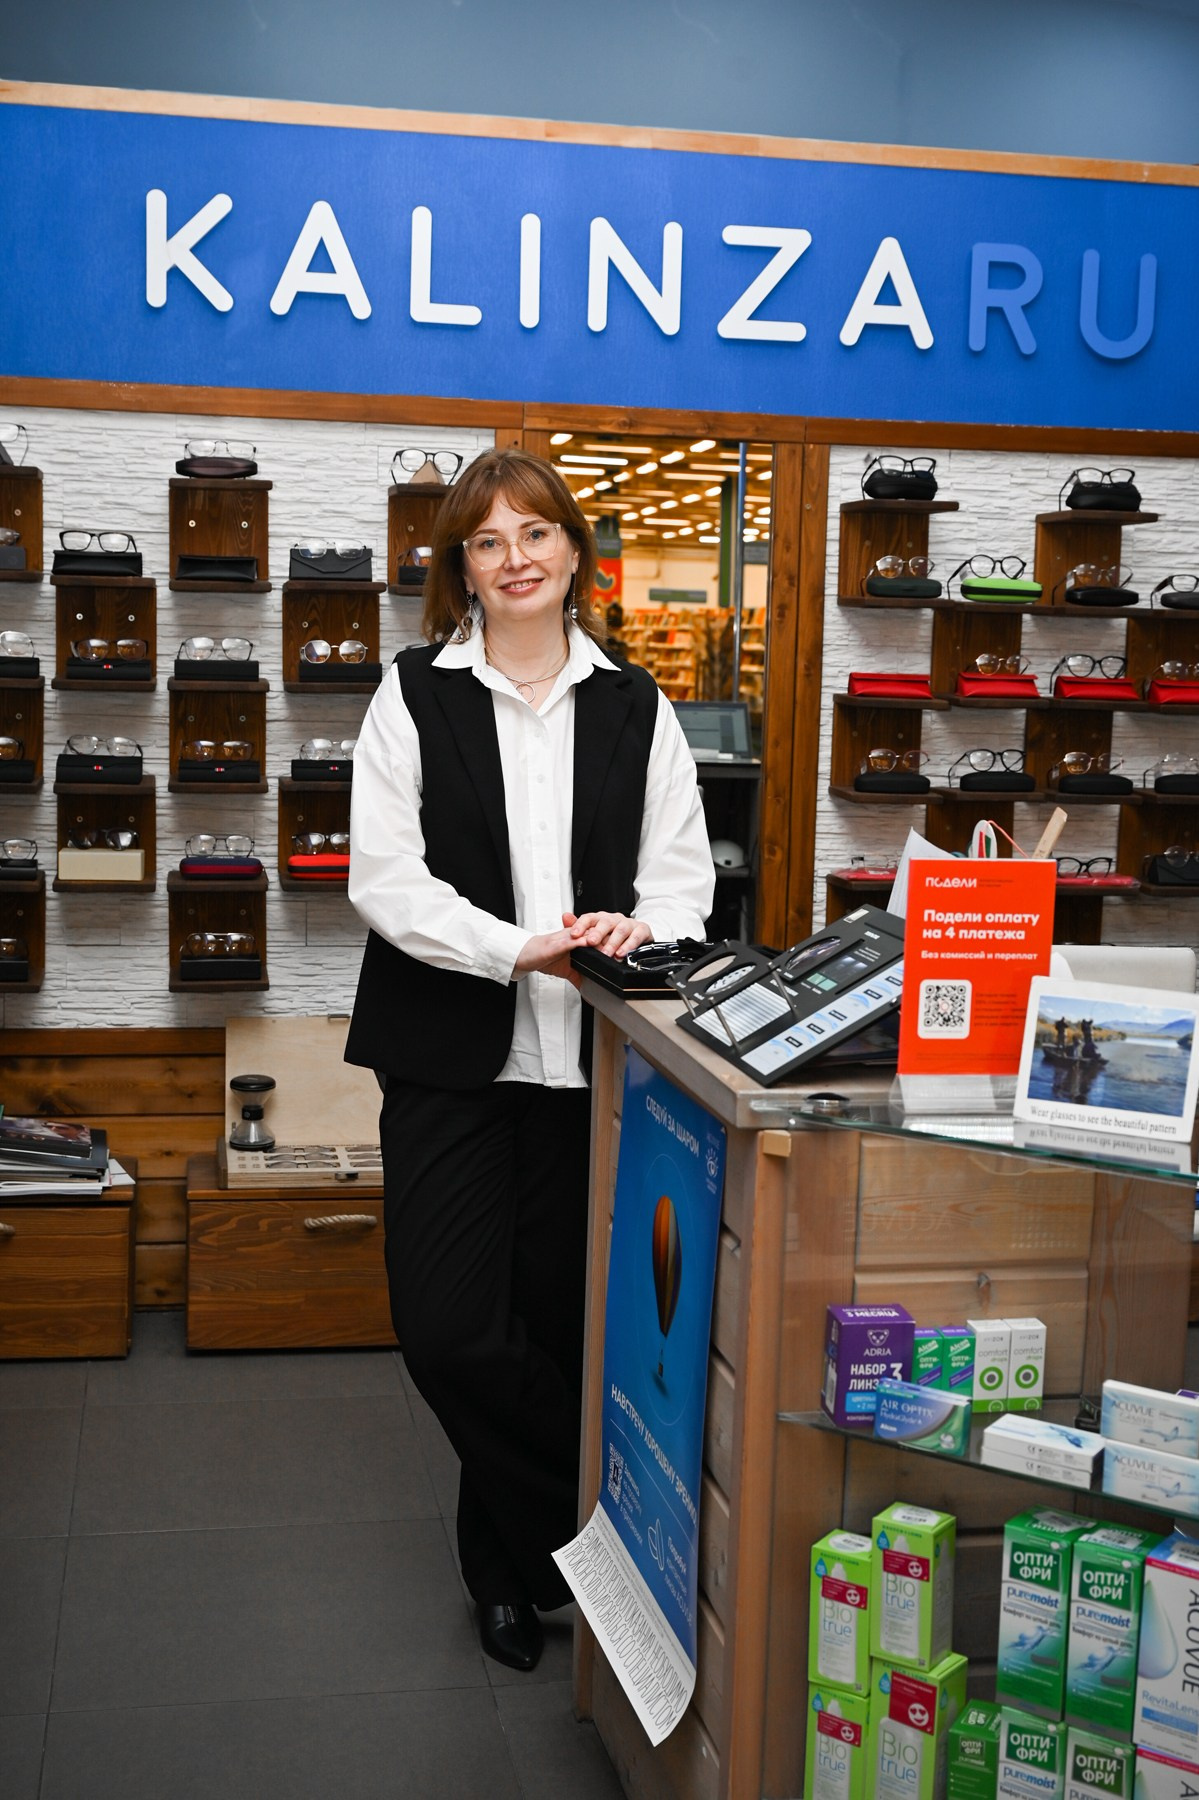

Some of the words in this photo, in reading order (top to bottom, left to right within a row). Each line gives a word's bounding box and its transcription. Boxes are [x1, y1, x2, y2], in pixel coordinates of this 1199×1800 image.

[923, 909, 982, 924] Подели
[985, 912, 1040, 926] оплату
[922, 929, 942, 939] на
[945, 927, 956, 939] 4
[958, 929, 1026, 940] платежа
[921, 950, 939, 959] Без
[940, 951, 986, 959] комиссий
[994, 953, 1038, 961] переплат
[646, 1094, 668, 1127] СЛЕДУЙ
[667, 1114, 676, 1135] ЗА
[676, 1121, 700, 1158] ШАРОМ
[1030, 1106, 1049, 1118] Wear
[1050, 1109, 1077, 1122] glasses
[1078, 1113, 1086, 1122] to
[1087, 1116, 1100, 1125] see
[1101, 1115, 1113, 1127] the
[1114, 1117, 1148, 1131] beautiful
[1149, 1123, 1177, 1135] pattern
[863, 1348, 892, 1356] ADRIA
[978, 1349, 1008, 1358] comfort
[1014, 1347, 1043, 1356] comfort
[850, 1364, 887, 1375] НАБОР
[890, 1363, 903, 1381] 3
[848, 1379, 880, 1390] ЛИНЗ
[881, 1399, 899, 1411] AIR
[901, 1403, 934, 1418] OPTIX
[1111, 1400, 1155, 1417] ACUVUE
[611, 1384, 645, 1436] НАВСТРЕЧУ
[644, 1428, 676, 1484] ХОРОШЕМУ
[675, 1475, 697, 1528] ЗРЕНИЮ
[1113, 1456, 1156, 1472] ACUVUE
[1013, 1551, 1058, 1568] ОПТИ-
[1019, 1565, 1052, 1580] ФРИ
[1082, 1570, 1129, 1586] ОПТИ-
[562, 1541, 629, 1646] ПРОКОНСУЛЬТИРОВАТЬСЯ
[1007, 1586, 1059, 1609] puremoist
[1089, 1585, 1123, 1600] ФРИ
[885, 1593, 915, 1612] true
[1003, 1606, 1024, 1618] Комфорт
[1076, 1606, 1130, 1629] puremoist
[585, 1533, 613, 1579] ИМЕЮТСЯ
[648, 1641, 687, 1713] НЕОБХОДИМО
[823, 1619, 852, 1638] true
[1072, 1626, 1094, 1639] Комфорт
[616, 1635, 636, 1659] СО
[624, 1648, 677, 1735] СПЕЦИАЛИСТОМ
[1010, 1732, 1055, 1749] ОПТИ-
[818, 1753, 846, 1774] true
[1016, 1748, 1049, 1762] ФРИ
[1076, 1755, 1121, 1772] ОПТИ-
[880, 1756, 917, 1784] true
[1003, 1766, 1057, 1790] puremoist
[1082, 1770, 1115, 1786] ФРИ
